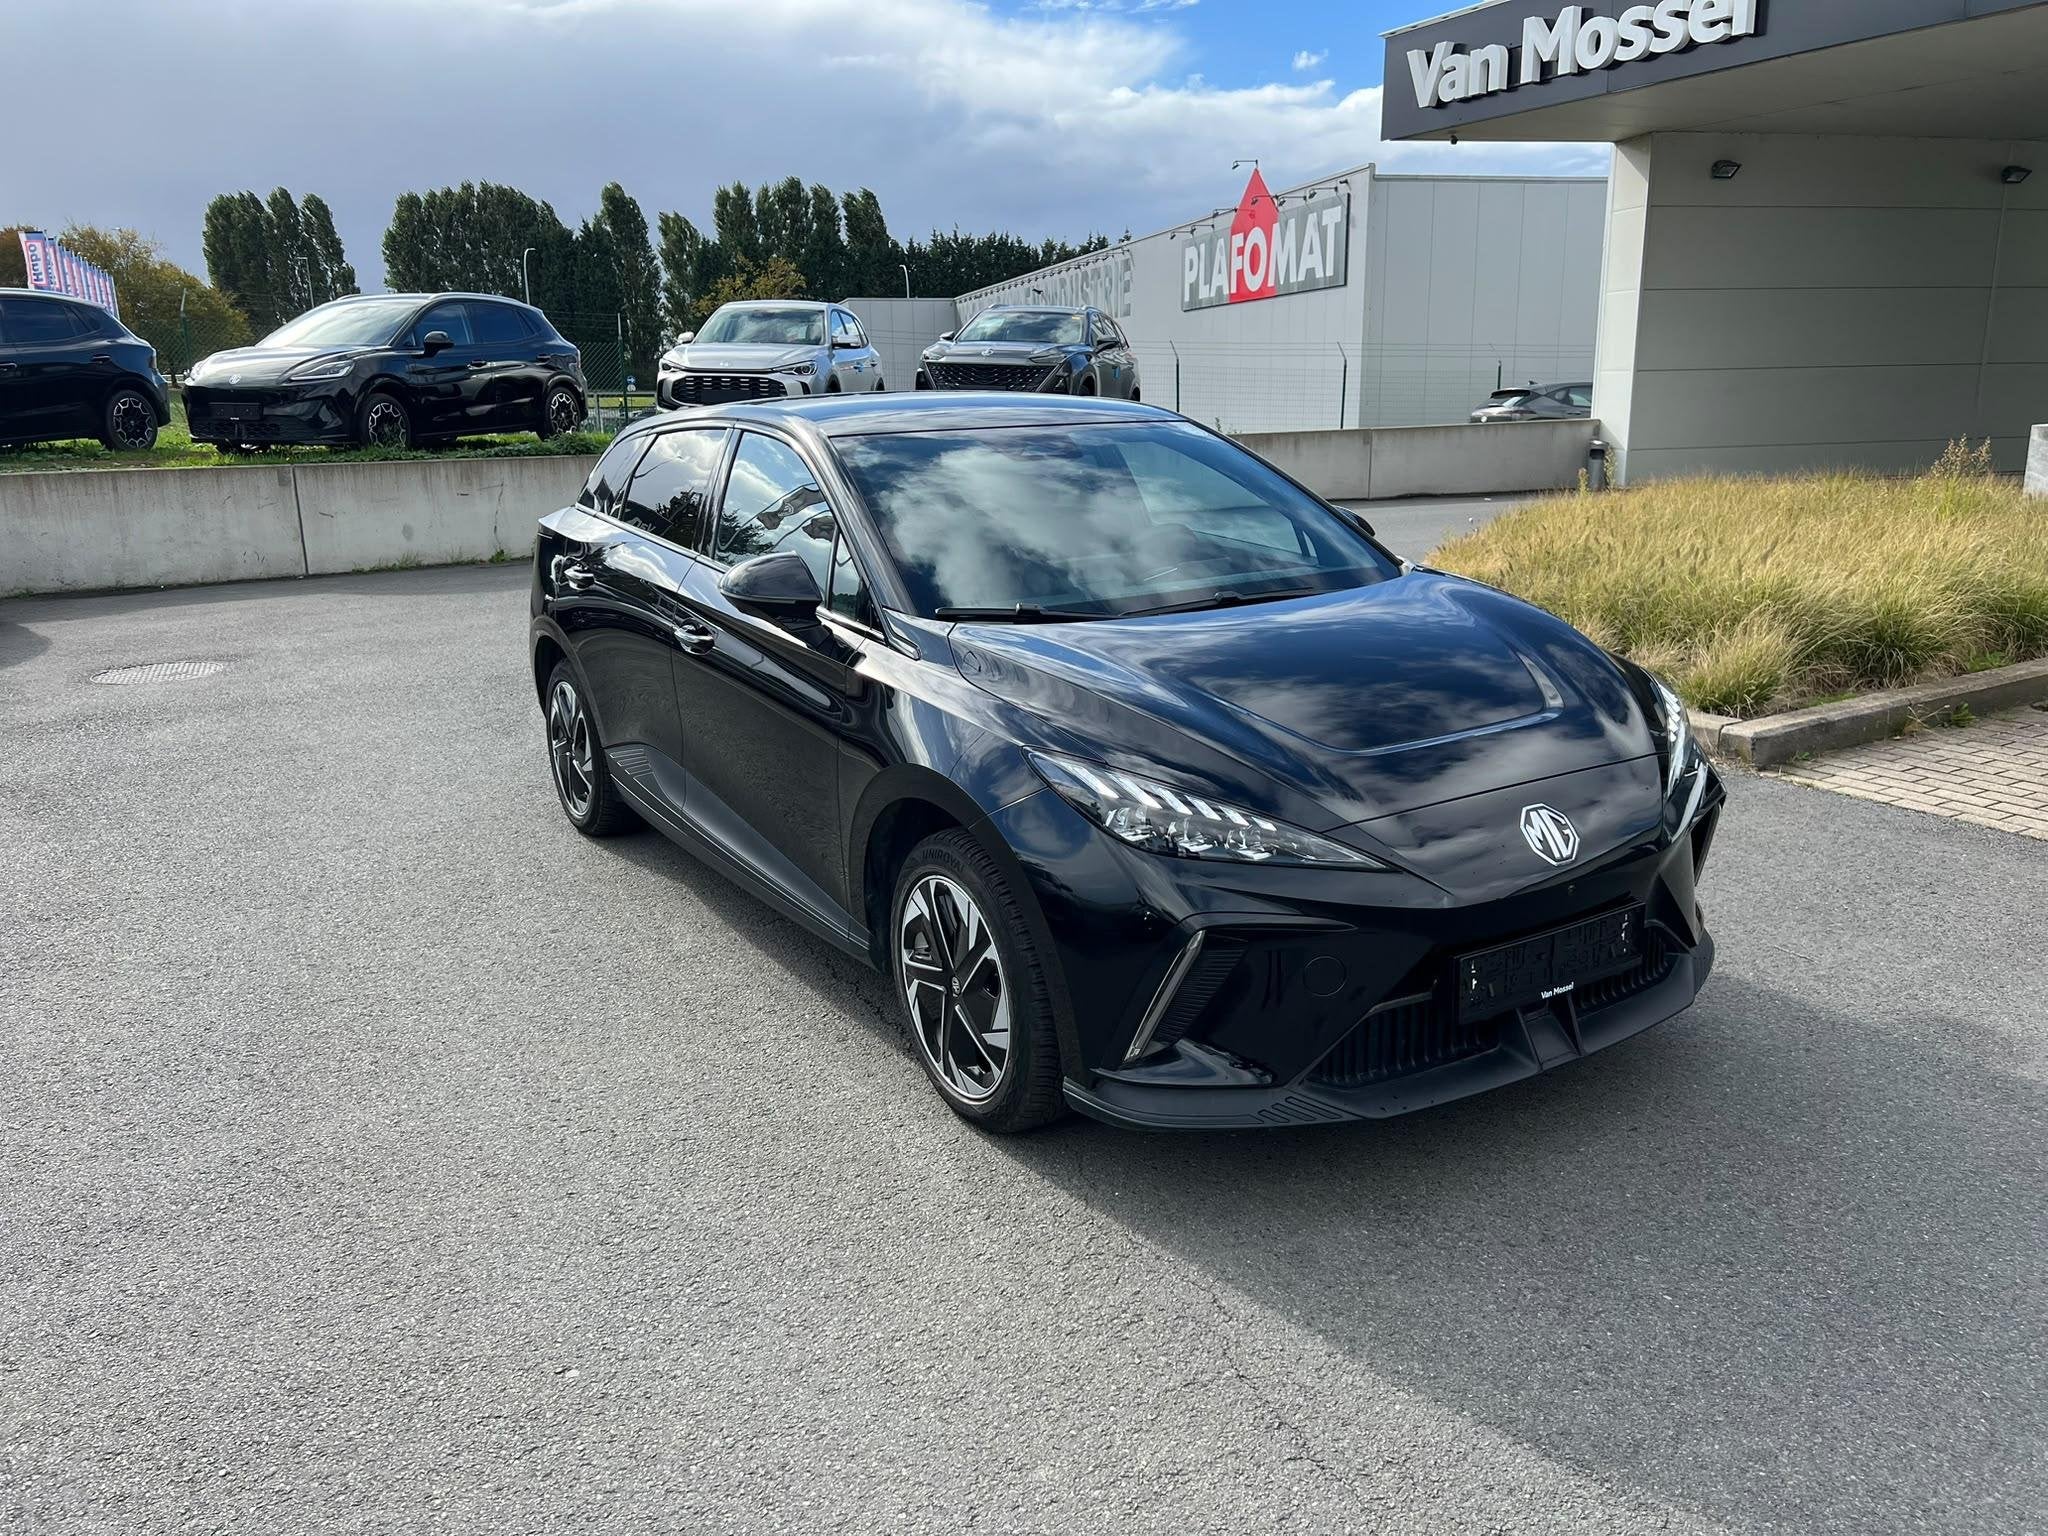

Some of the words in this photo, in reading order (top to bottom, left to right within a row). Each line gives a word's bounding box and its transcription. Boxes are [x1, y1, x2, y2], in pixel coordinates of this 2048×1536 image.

[1406, 41, 1508, 108] Van
[1184, 205, 1343, 302] PLAFOMAT
[1525, 808, 1574, 860] MG
[1540, 990, 1553, 999] Van
[1553, 981, 1574, 996] Mossel
